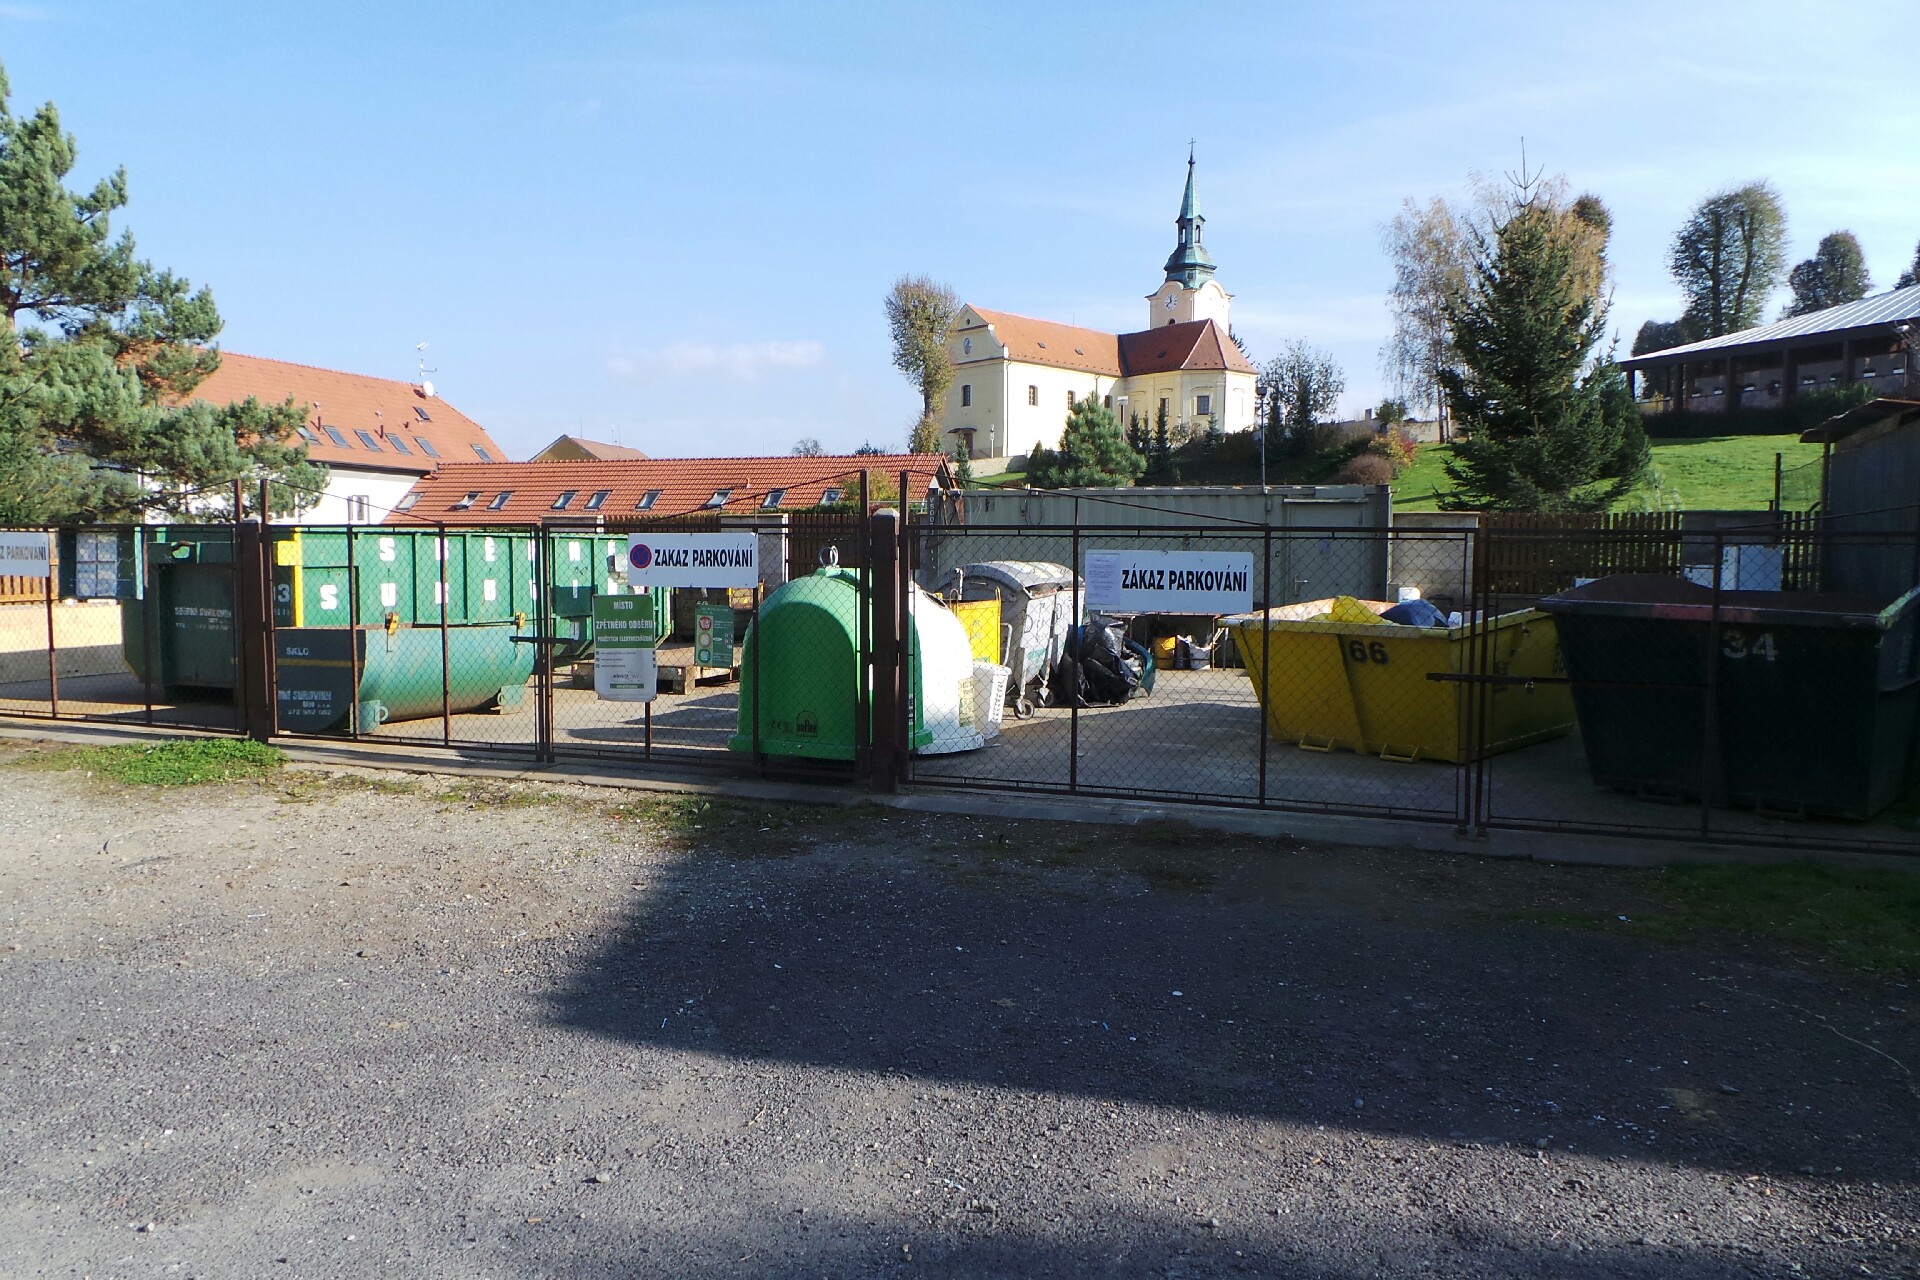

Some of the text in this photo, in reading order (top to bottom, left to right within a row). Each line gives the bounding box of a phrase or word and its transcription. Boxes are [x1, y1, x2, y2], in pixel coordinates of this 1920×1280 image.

[6, 541, 47, 560] PARKOVÁNÍ
[654, 543, 753, 567] ZAKAZ PARKOVÁNÍ
[1121, 563, 1165, 590] ZÁKAZ
[1168, 564, 1248, 592] PARKOVÁNÍ
[613, 600, 634, 610] MÍSTO
[1349, 639, 1389, 665] 66
[1722, 630, 1780, 661] 34
